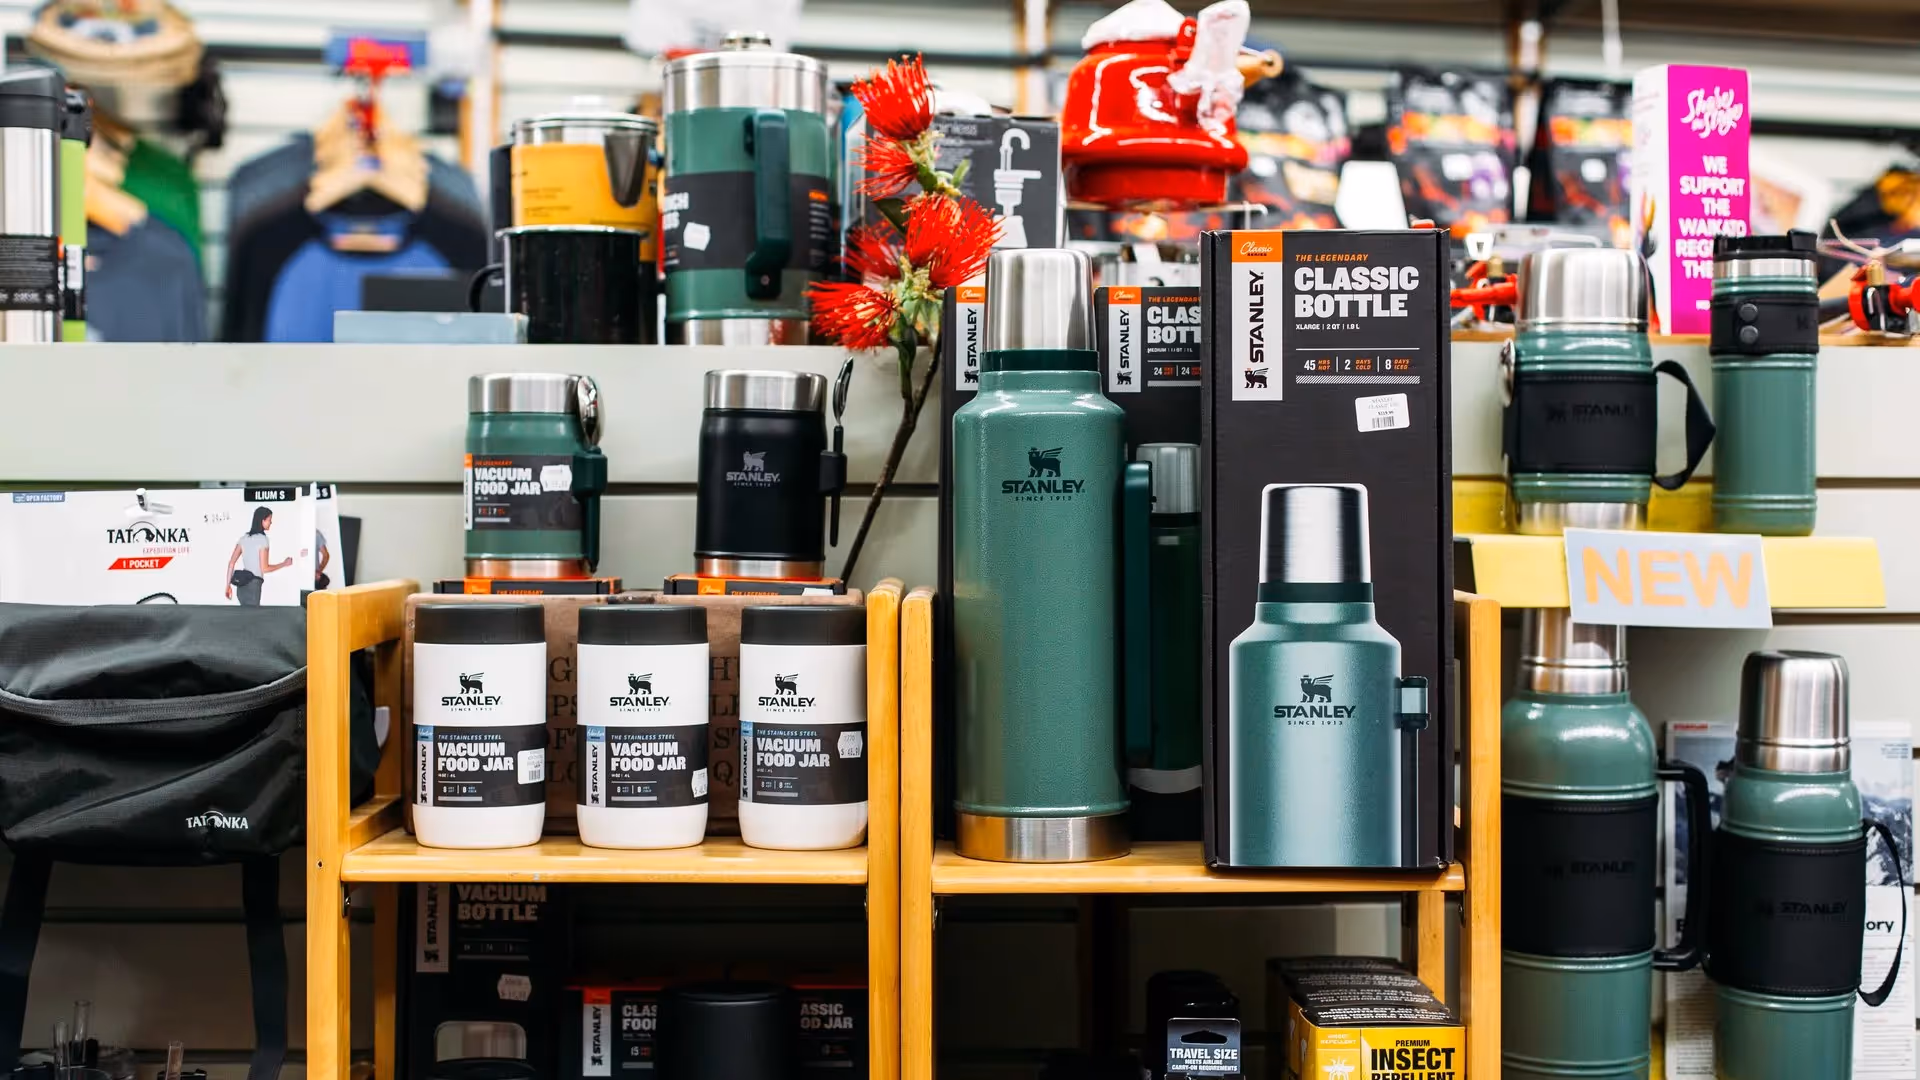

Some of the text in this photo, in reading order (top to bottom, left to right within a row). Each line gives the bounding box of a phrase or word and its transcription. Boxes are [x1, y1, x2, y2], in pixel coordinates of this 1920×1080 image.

[1702, 155, 1728, 174] WE
[1679, 176, 1745, 197] SUPPORT
[1701, 197, 1730, 217] THE
[1240, 241, 1273, 255] Classic
[1295, 254, 1368, 262] THE LEGENDARY
[1294, 266, 1419, 291] CLASSIC
[1295, 293, 1408, 318] BOTTLE
[1249, 270, 1264, 363] STANLEY
[967, 308, 977, 367] STANLEY
[1120, 309, 1130, 368] STANLEY
[1154, 366, 1162, 376] 24
[1182, 366, 1190, 376] 24
[1304, 360, 1316, 370] 45
[1344, 359, 1350, 370] 2
[1386, 359, 1392, 370] 8
[474, 468, 532, 482] VACUUM
[726, 472, 780, 482] STANLEY
[474, 482, 509, 496] FOOD
[510, 482, 541, 496] JAR
[1001, 479, 1085, 494] STANLEY
[26, 494, 63, 502] OPEN FACTORY
[255, 490, 285, 500] ILIUM S
[107, 524, 190, 544] TATONKA
[129, 559, 160, 569] POCKET
[1582, 546, 1753, 609] NEW
[441, 696, 502, 706] STANLEY
[610, 696, 670, 706] STANLEY
[758, 696, 816, 708] STANLEY
[1273, 705, 1356, 719] STANLEY
[438, 742, 506, 756] VACUUM
[610, 742, 678, 756] VACUUM
[756, 738, 821, 752] VACUUM
[438, 757, 480, 772] FOOD
[483, 757, 514, 772] JAR
[610, 756, 686, 772] FOOD JAR
[756, 753, 830, 767] FOOD JAR
[186, 813, 248, 829] TATONKA
[456, 884, 547, 902] VACUUM
[457, 904, 538, 921] BOTTLE
[1865, 920, 1894, 933] ory
[824, 1016, 854, 1029] JAR
[592, 1006, 601, 1054] STANLEY
[1170, 1048, 1238, 1060] TRAVEL SIZE
[1372, 1048, 1456, 1071] INSECT
